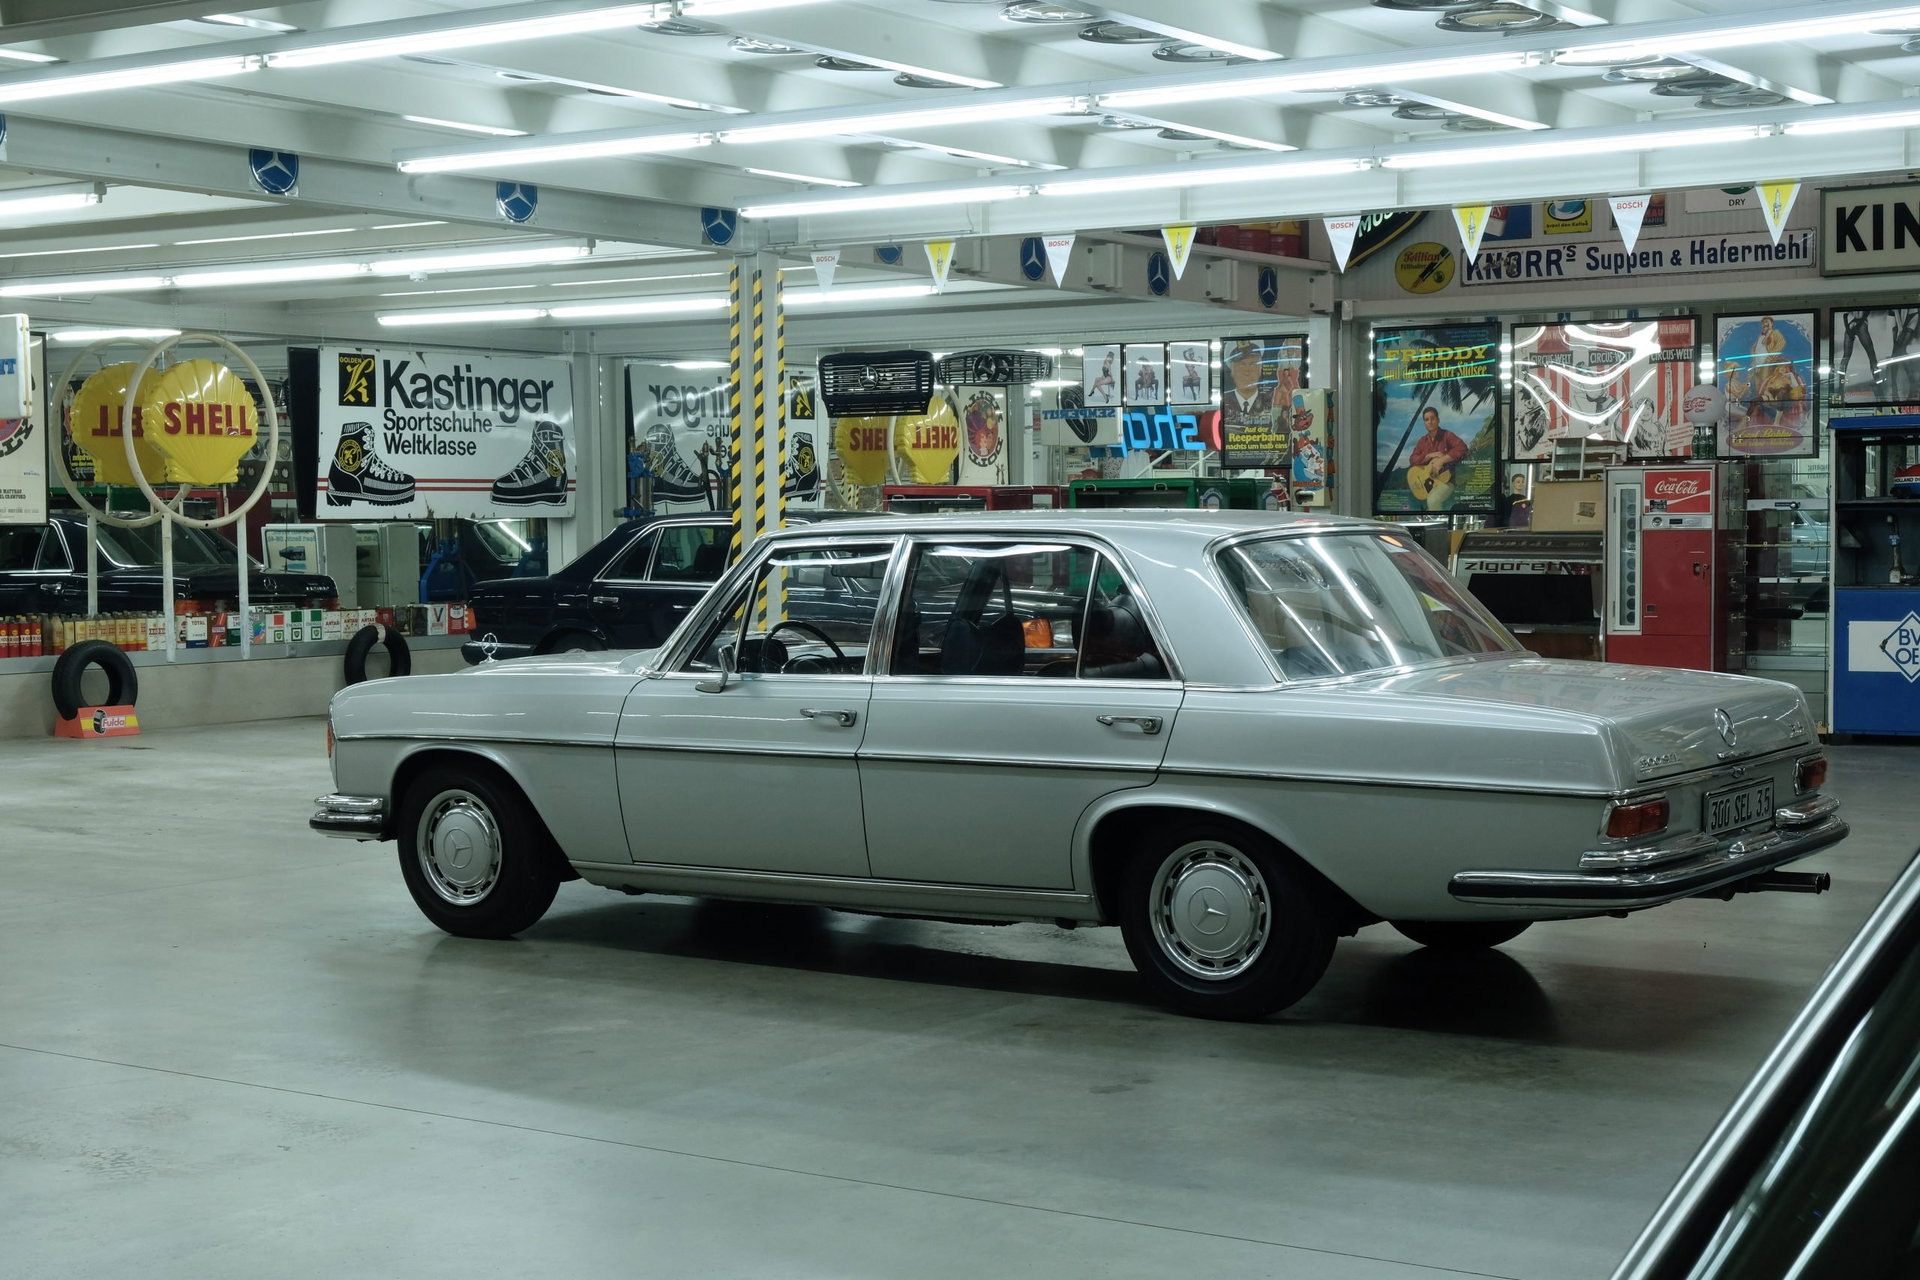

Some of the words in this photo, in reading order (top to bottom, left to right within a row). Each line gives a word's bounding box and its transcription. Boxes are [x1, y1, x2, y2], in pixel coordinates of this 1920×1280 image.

[1616, 201, 1643, 210] BOSCH
[1728, 198, 1746, 207] DRY
[1330, 222, 1354, 230] BOSCH
[1047, 239, 1070, 248] BOSCH
[815, 255, 836, 263] BOSCH
[1586, 246, 1663, 275] Suppen
[1670, 249, 1682, 267] &
[1690, 233, 1808, 266] Hafermehl
[1384, 346, 1489, 362] FREDDY
[1420, 362, 1439, 379] Lied
[383, 359, 554, 424] Kastinger
[164, 402, 252, 438] SHELL
[383, 408, 492, 433] Sportschuhe
[383, 433, 477, 456] Weltklasse
[1229, 432, 1285, 443] Reeperbahn
[1655, 480, 1700, 494] Coca-Cola
[102, 717, 124, 727] Fulda
[1711, 798, 1730, 830] 300
[1734, 792, 1752, 824] SEL
[1756, 787, 1770, 817] 3.5
